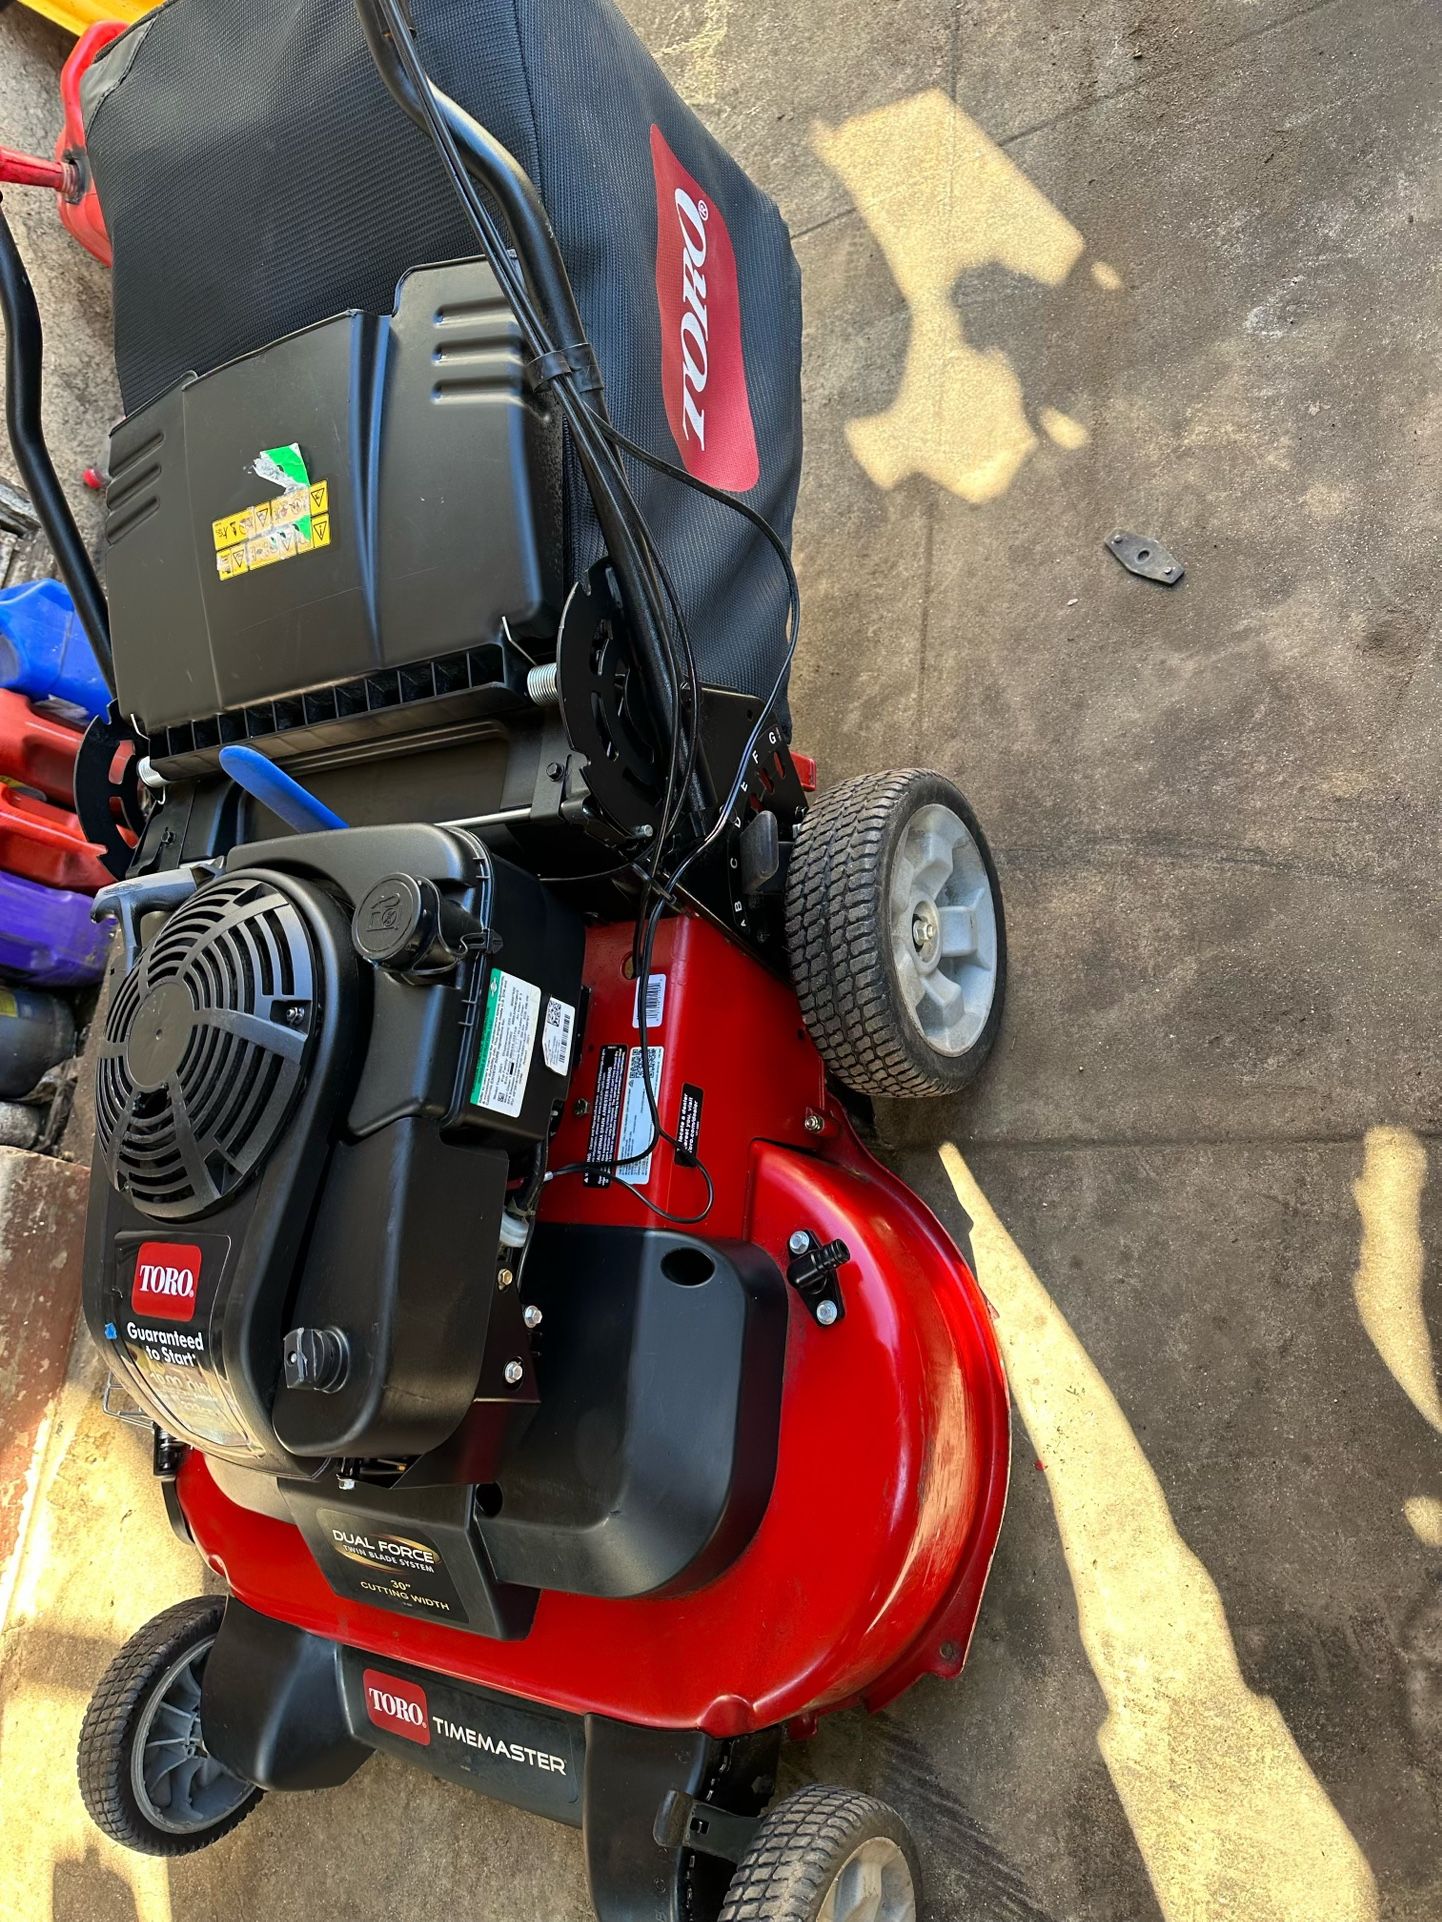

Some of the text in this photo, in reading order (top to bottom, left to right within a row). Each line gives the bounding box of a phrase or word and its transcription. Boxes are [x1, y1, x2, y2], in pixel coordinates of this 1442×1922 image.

[768, 732, 776, 744] G
[752, 750, 758, 764] F
[730, 858, 738, 868] C
[734, 900, 742, 912] B
[602, 1089, 610, 1116] ARRESTER
[127, 1322, 204, 1350] Guaranteed
[146, 1346, 160, 1360] to
[332, 1529, 435, 1564] DUAL FORCE
[343, 1544, 435, 1574] TWIN BLADE SYSTEM
[360, 1581, 450, 1611] CUTTING WIDTH
[432, 1716, 567, 1776] TIMEMASTER
